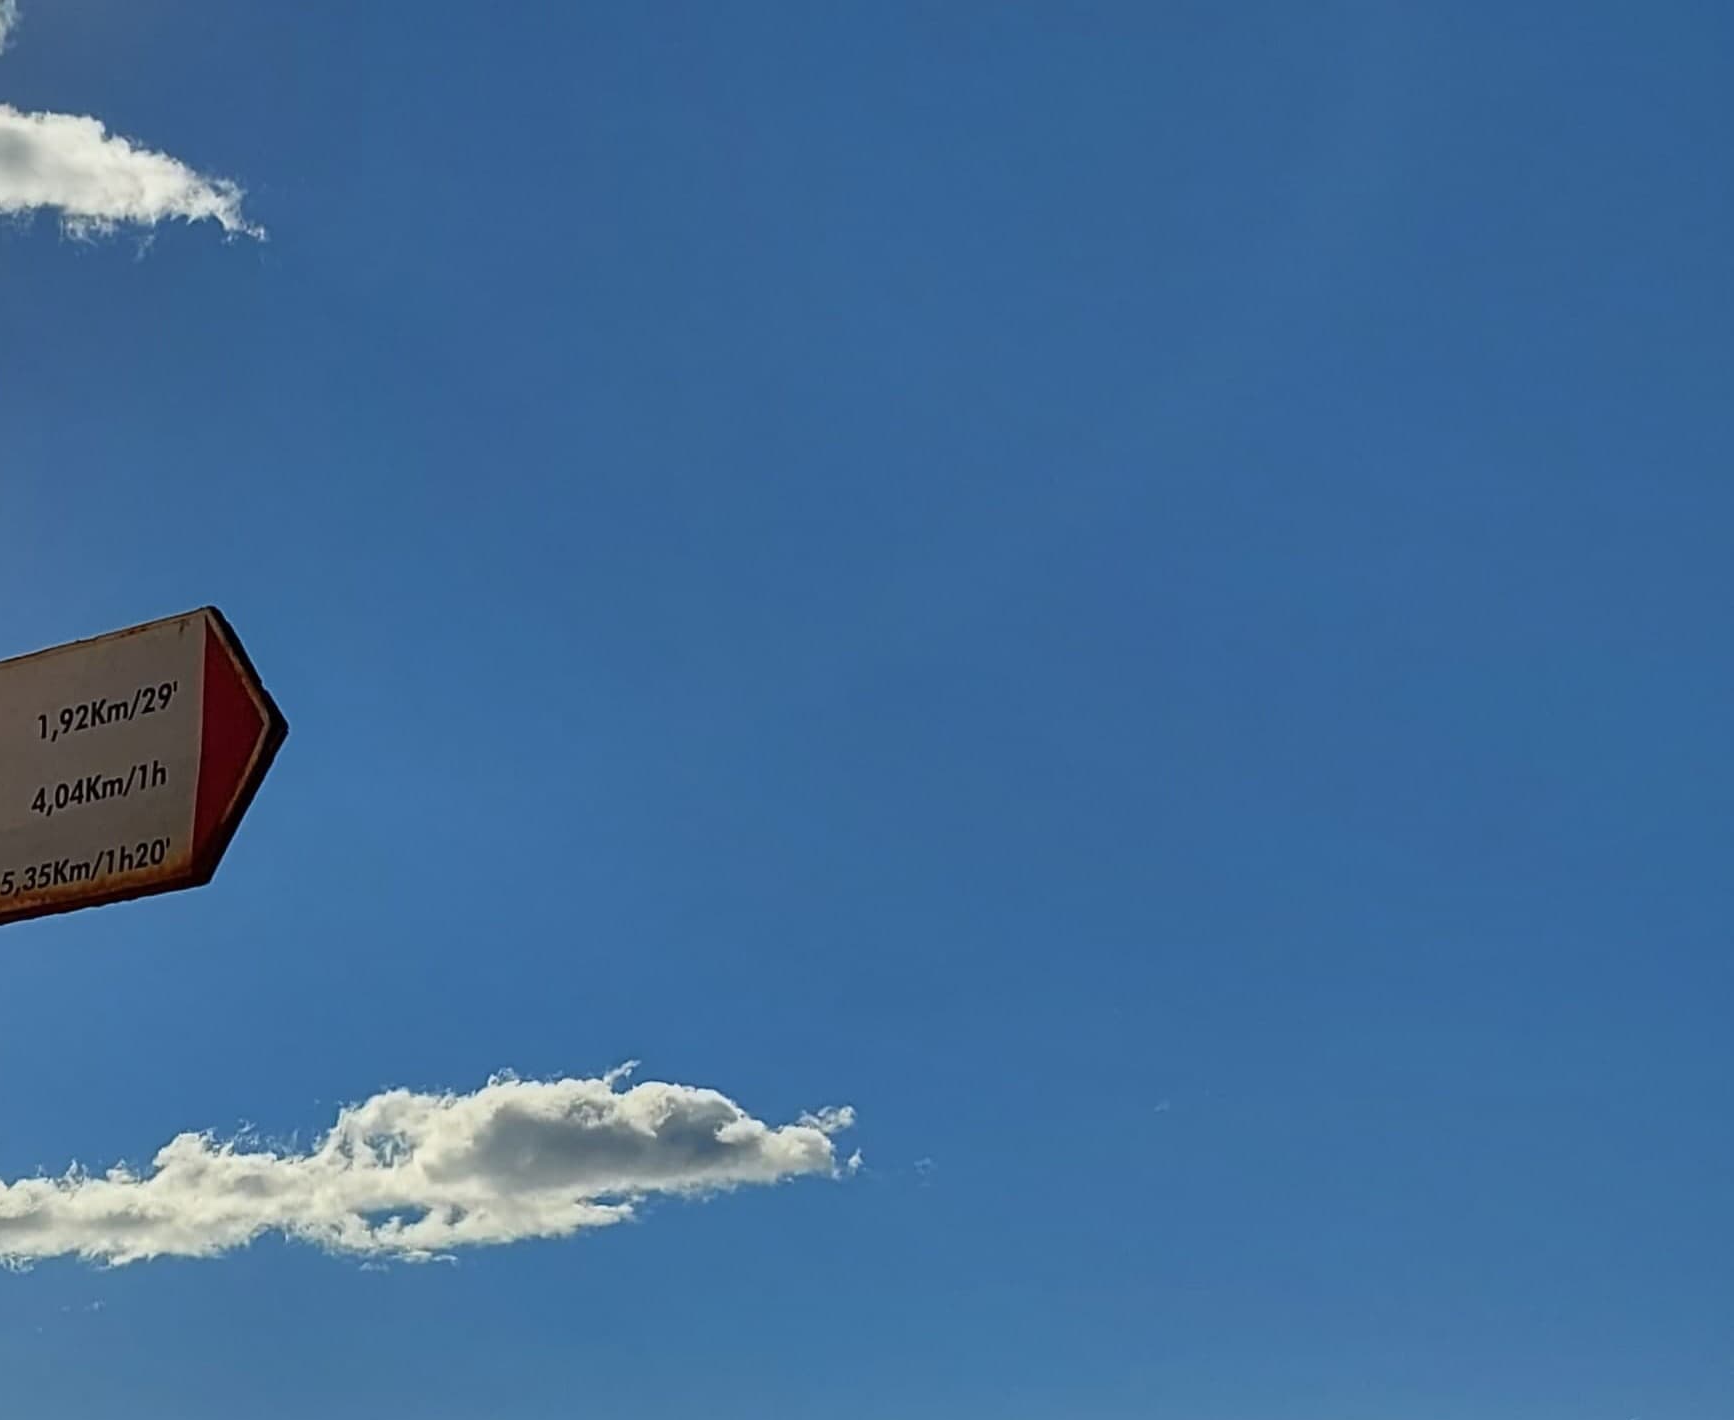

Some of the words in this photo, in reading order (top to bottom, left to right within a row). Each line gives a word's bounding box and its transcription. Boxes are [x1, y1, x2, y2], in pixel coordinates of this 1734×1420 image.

[37, 681, 179, 742] 1,92Km/29'
[32, 760, 167, 817] 4,04Km/1h
[0, 838, 171, 898] 5,35Km/1h20'
